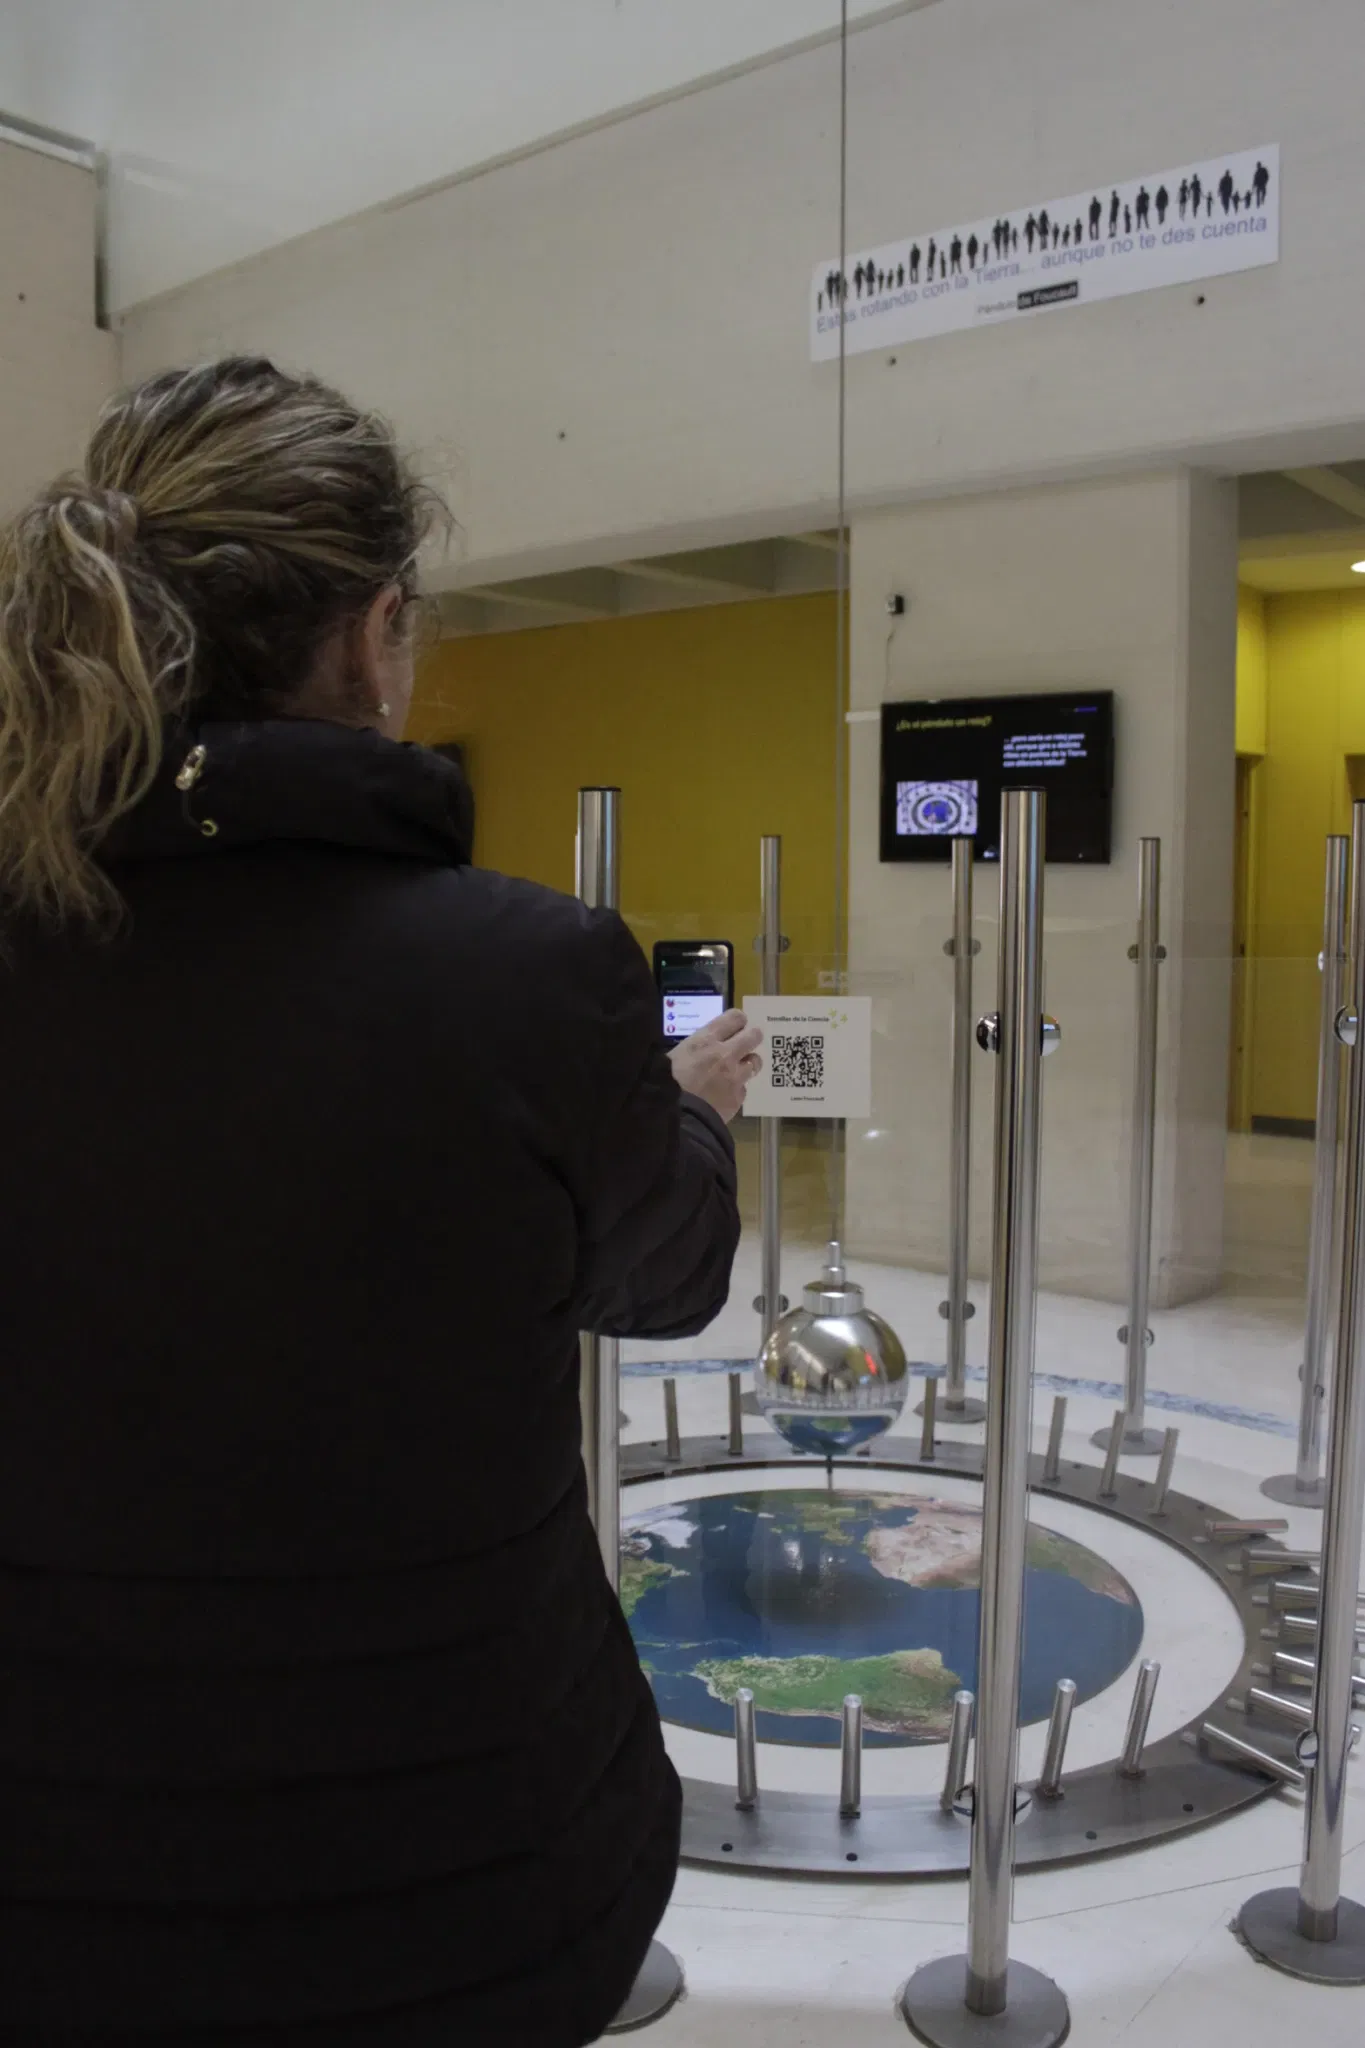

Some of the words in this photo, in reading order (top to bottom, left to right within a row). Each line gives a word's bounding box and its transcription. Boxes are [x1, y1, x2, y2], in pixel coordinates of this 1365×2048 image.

[861, 287, 918, 317] rotando
[922, 282, 951, 300] con
[955, 275, 969, 290] la
[1040, 246, 1106, 270] aunque
[1110, 237, 1134, 255] no
[1139, 232, 1156, 249] te
[1161, 225, 1195, 246] des
[1201, 215, 1268, 240] cuenta
